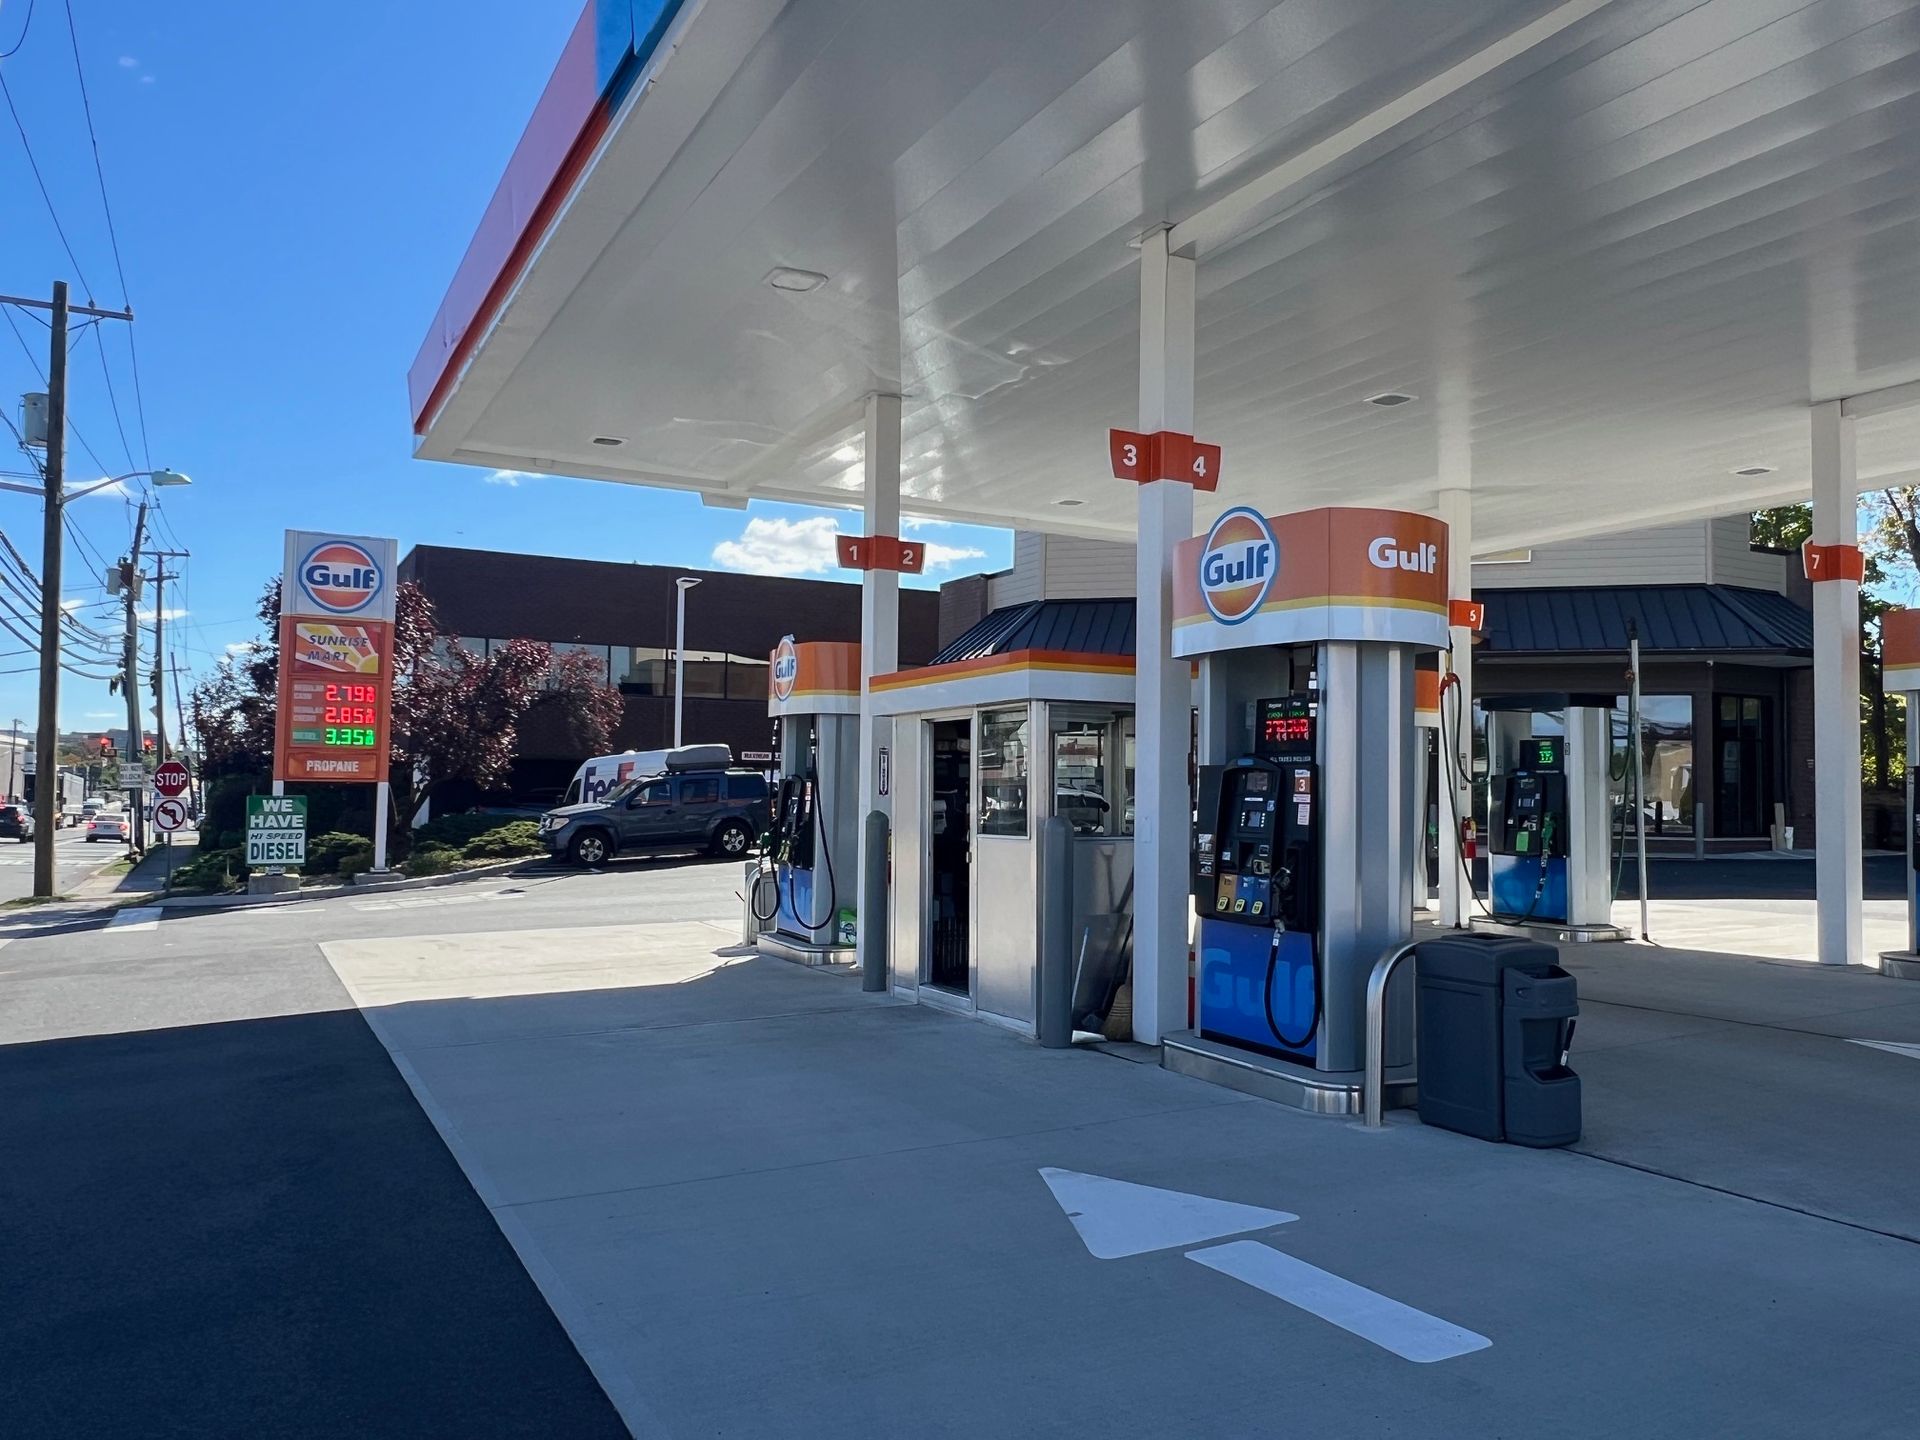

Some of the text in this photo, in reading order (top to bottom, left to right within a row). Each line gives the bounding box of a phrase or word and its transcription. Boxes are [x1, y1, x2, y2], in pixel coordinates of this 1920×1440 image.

[1122, 444, 1137, 467] 3
[1192, 455, 1207, 477] 4
[848, 545, 858, 561] 1
[902, 549, 914, 566] 2
[1366, 537, 1437, 575] Gulf
[1203, 543, 1270, 587] Gulf
[1811, 553, 1820, 570] 7
[305, 564, 375, 589] Gulf
[308, 634, 368, 648] SUNRISE
[307, 650, 350, 661] MART
[775, 658, 796, 679] Gulf
[306, 759, 360, 773] PROPANE
[156, 772, 187, 787] STOP
[1298, 778, 1306, 792] 3
[262, 799, 293, 813] WE
[250, 814, 304, 828] HAVE
[265, 832, 303, 840] SPEED
[250, 842, 304, 860] DIESEL
